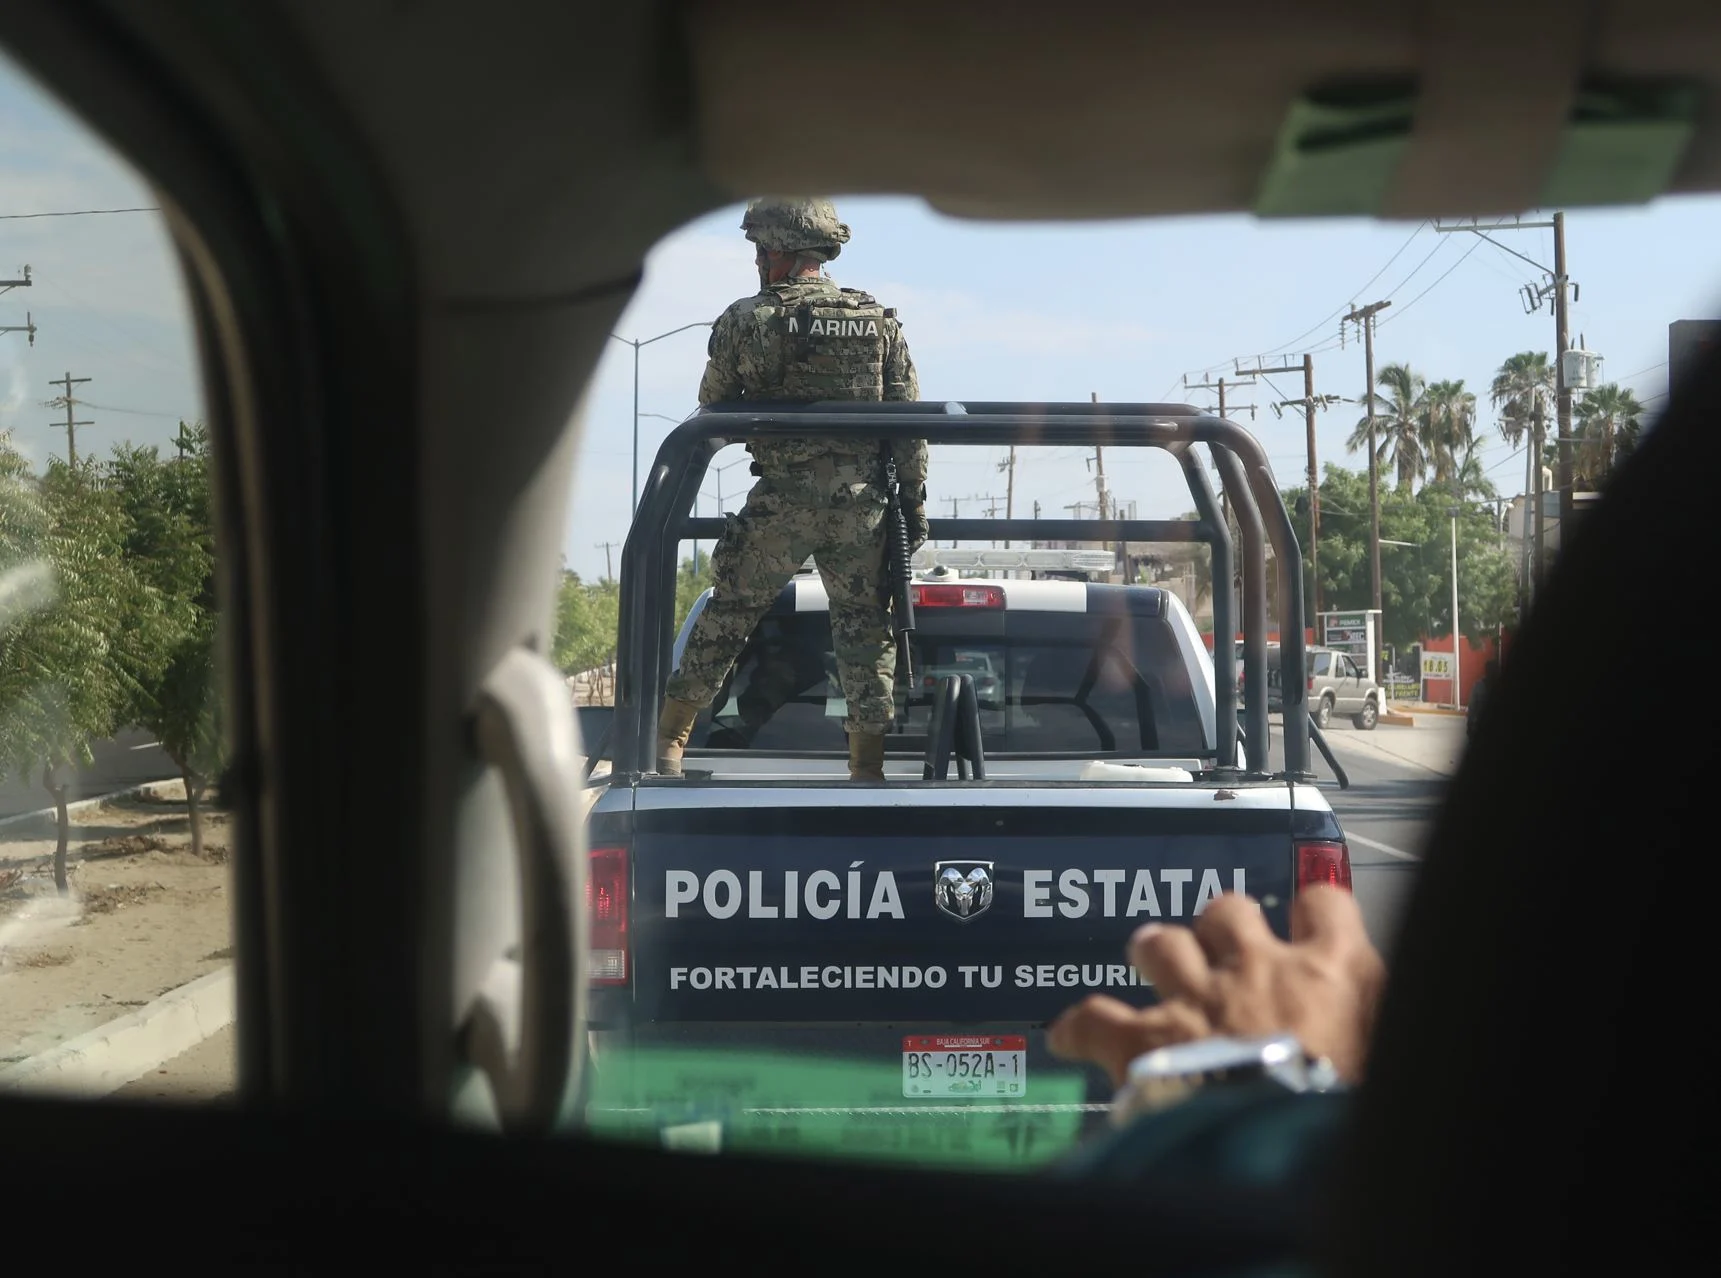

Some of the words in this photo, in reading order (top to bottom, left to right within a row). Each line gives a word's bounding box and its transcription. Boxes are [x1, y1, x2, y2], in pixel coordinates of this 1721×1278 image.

[665, 860, 906, 920] POLICÍA
[670, 966, 947, 990] FORTALECIENDO
[958, 966, 1003, 988] TU
[936, 1038, 950, 1046] BAJA
[950, 1038, 979, 1046] CALIFORNIA
[908, 1052, 1018, 1078] BS-052A-1
